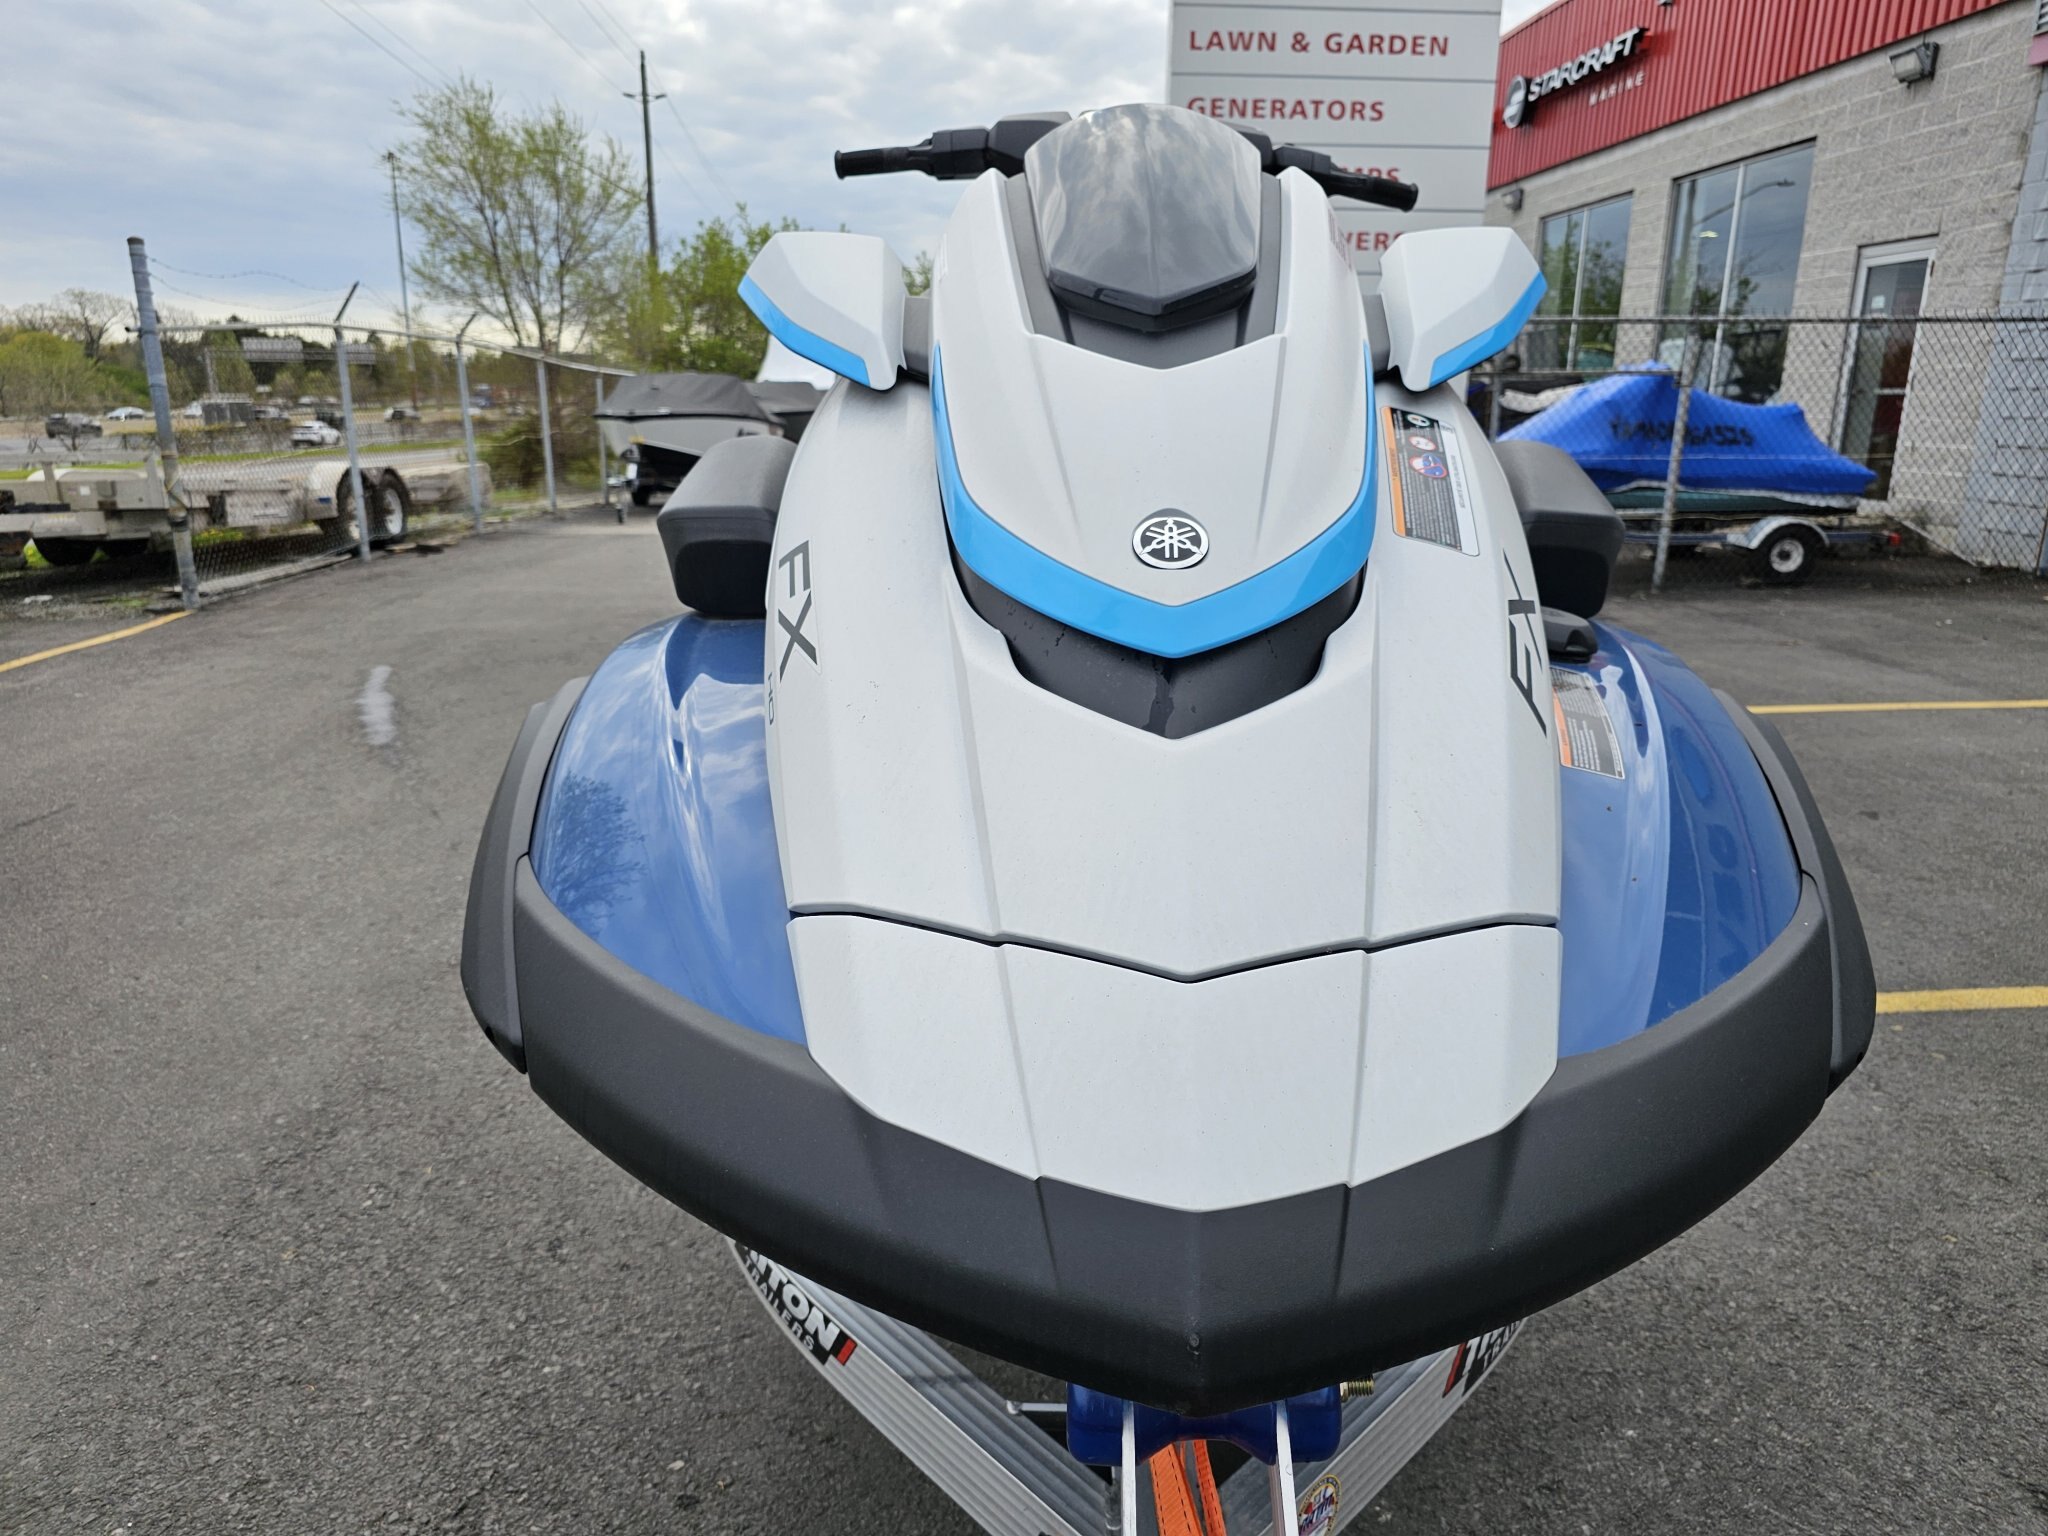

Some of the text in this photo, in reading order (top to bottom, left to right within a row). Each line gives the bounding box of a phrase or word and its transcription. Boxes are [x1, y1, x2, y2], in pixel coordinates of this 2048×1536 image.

[1188, 30, 1450, 57] LAWN & GARDEN
[1527, 26, 1642, 102] STARCRAFT
[1187, 97, 1386, 122] GENERATORS
[1588, 71, 1646, 107] MARINE
[778, 540, 818, 684] FX
[1503, 547, 1547, 738] FX
[745, 1254, 815, 1351] TRAILERS
